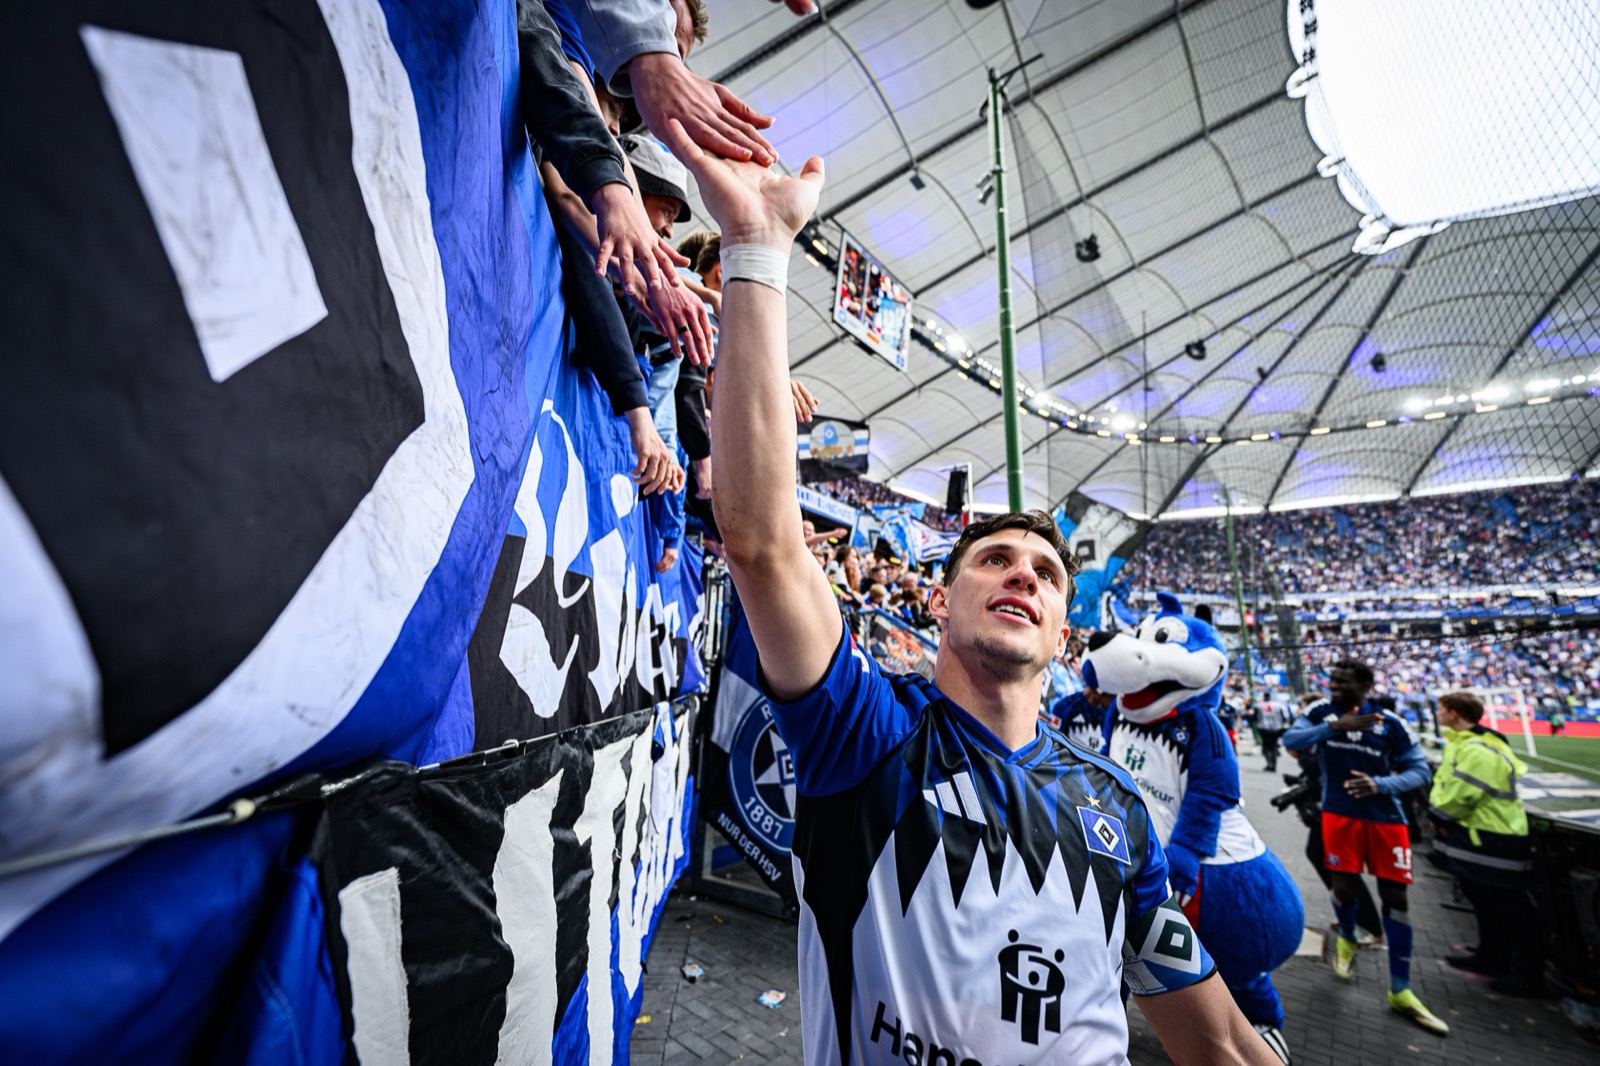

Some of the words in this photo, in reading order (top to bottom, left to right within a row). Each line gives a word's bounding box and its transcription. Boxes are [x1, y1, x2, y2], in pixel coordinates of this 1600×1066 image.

[744, 796, 783, 840] 1887
[717, 813, 740, 840] NUR
[738, 832, 761, 861] DER
[758, 854, 782, 882] HSV
